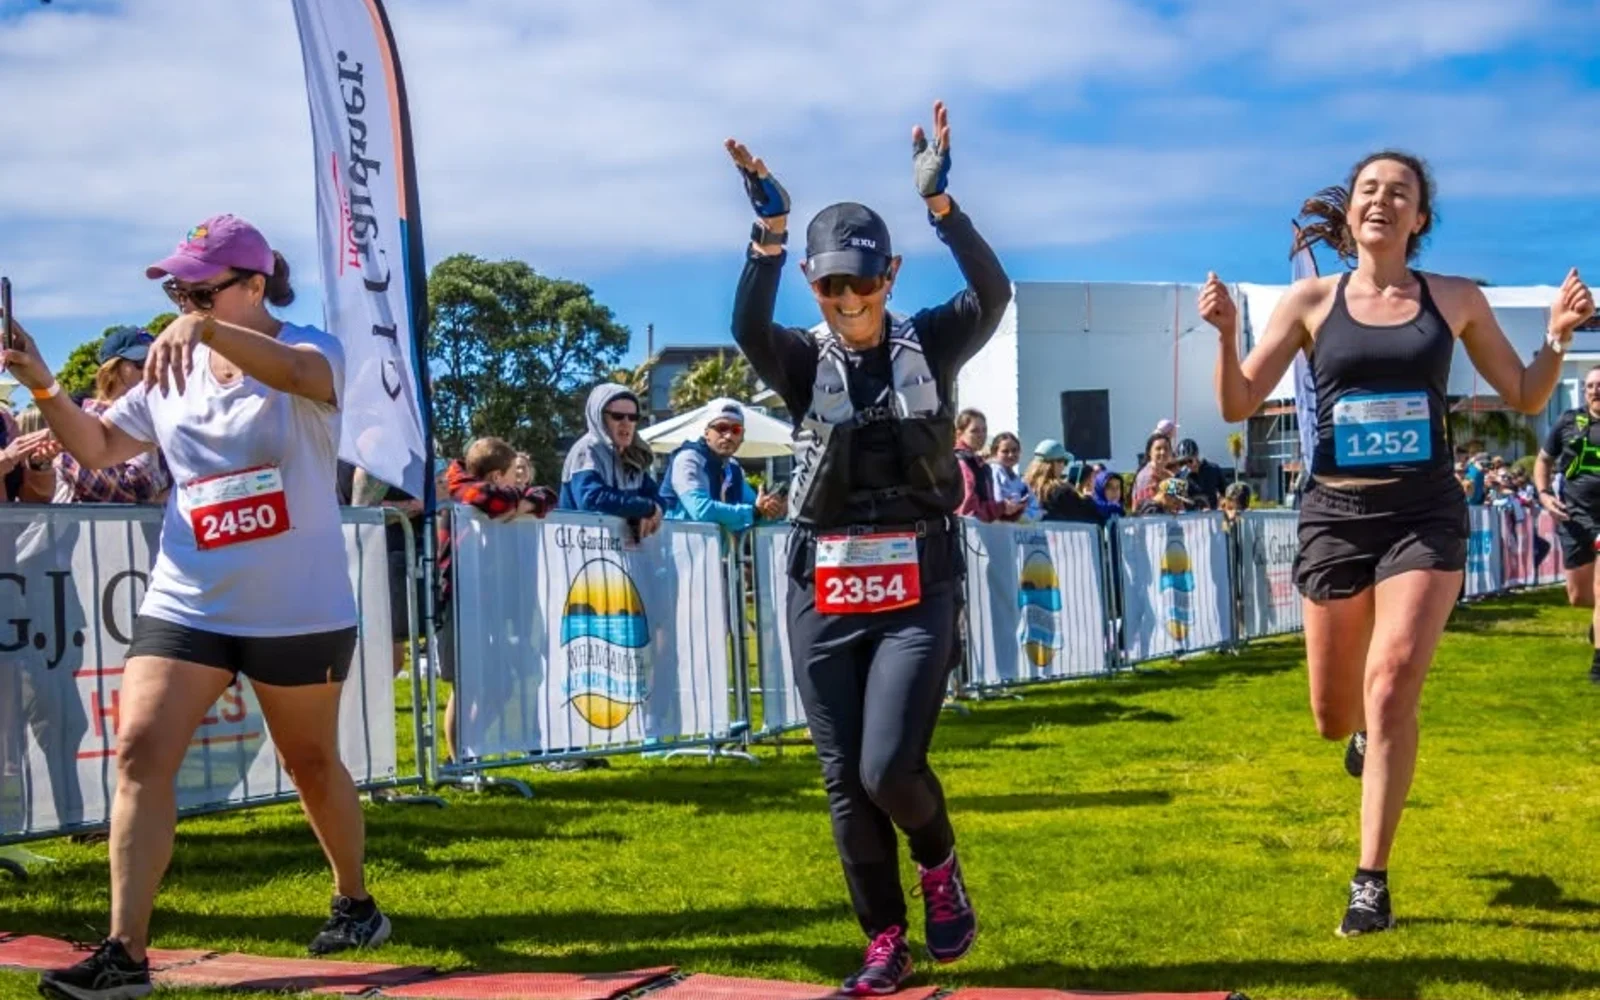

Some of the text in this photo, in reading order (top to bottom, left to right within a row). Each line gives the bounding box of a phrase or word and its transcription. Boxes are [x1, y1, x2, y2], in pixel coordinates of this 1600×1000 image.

[1347, 429, 1419, 457] 1252
[201, 504, 276, 541] 2450
[825, 574, 907, 604] 2354
